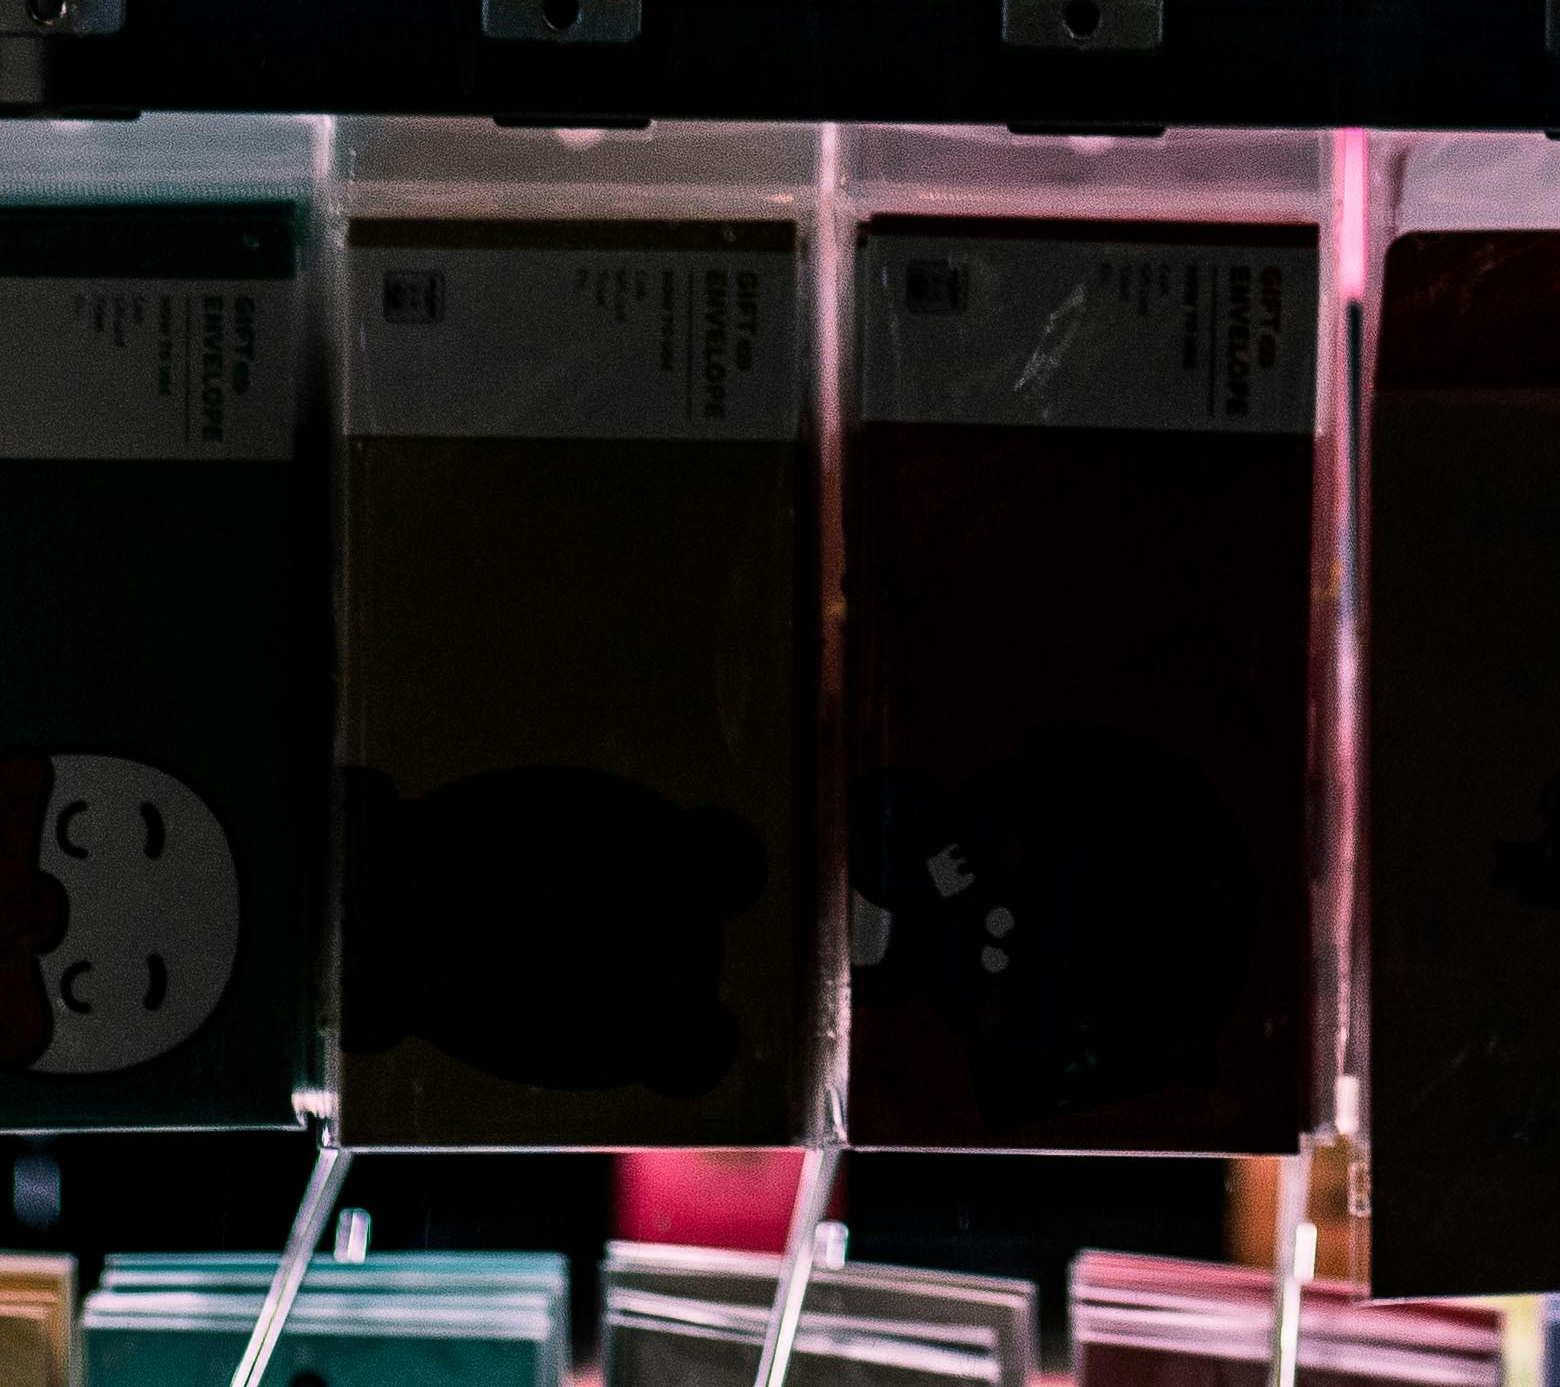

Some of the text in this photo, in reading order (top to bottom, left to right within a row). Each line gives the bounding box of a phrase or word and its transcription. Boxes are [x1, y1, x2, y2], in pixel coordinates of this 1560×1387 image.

[235, 296, 254, 362] GIFT
[706, 270, 727, 419] ENVELOPE
[737, 271, 757, 337] GIFT
[1226, 266, 1251, 417] ENVELOPE
[1262, 266, 1282, 331] GIFT
[202, 296, 223, 445] ENVELOPE
